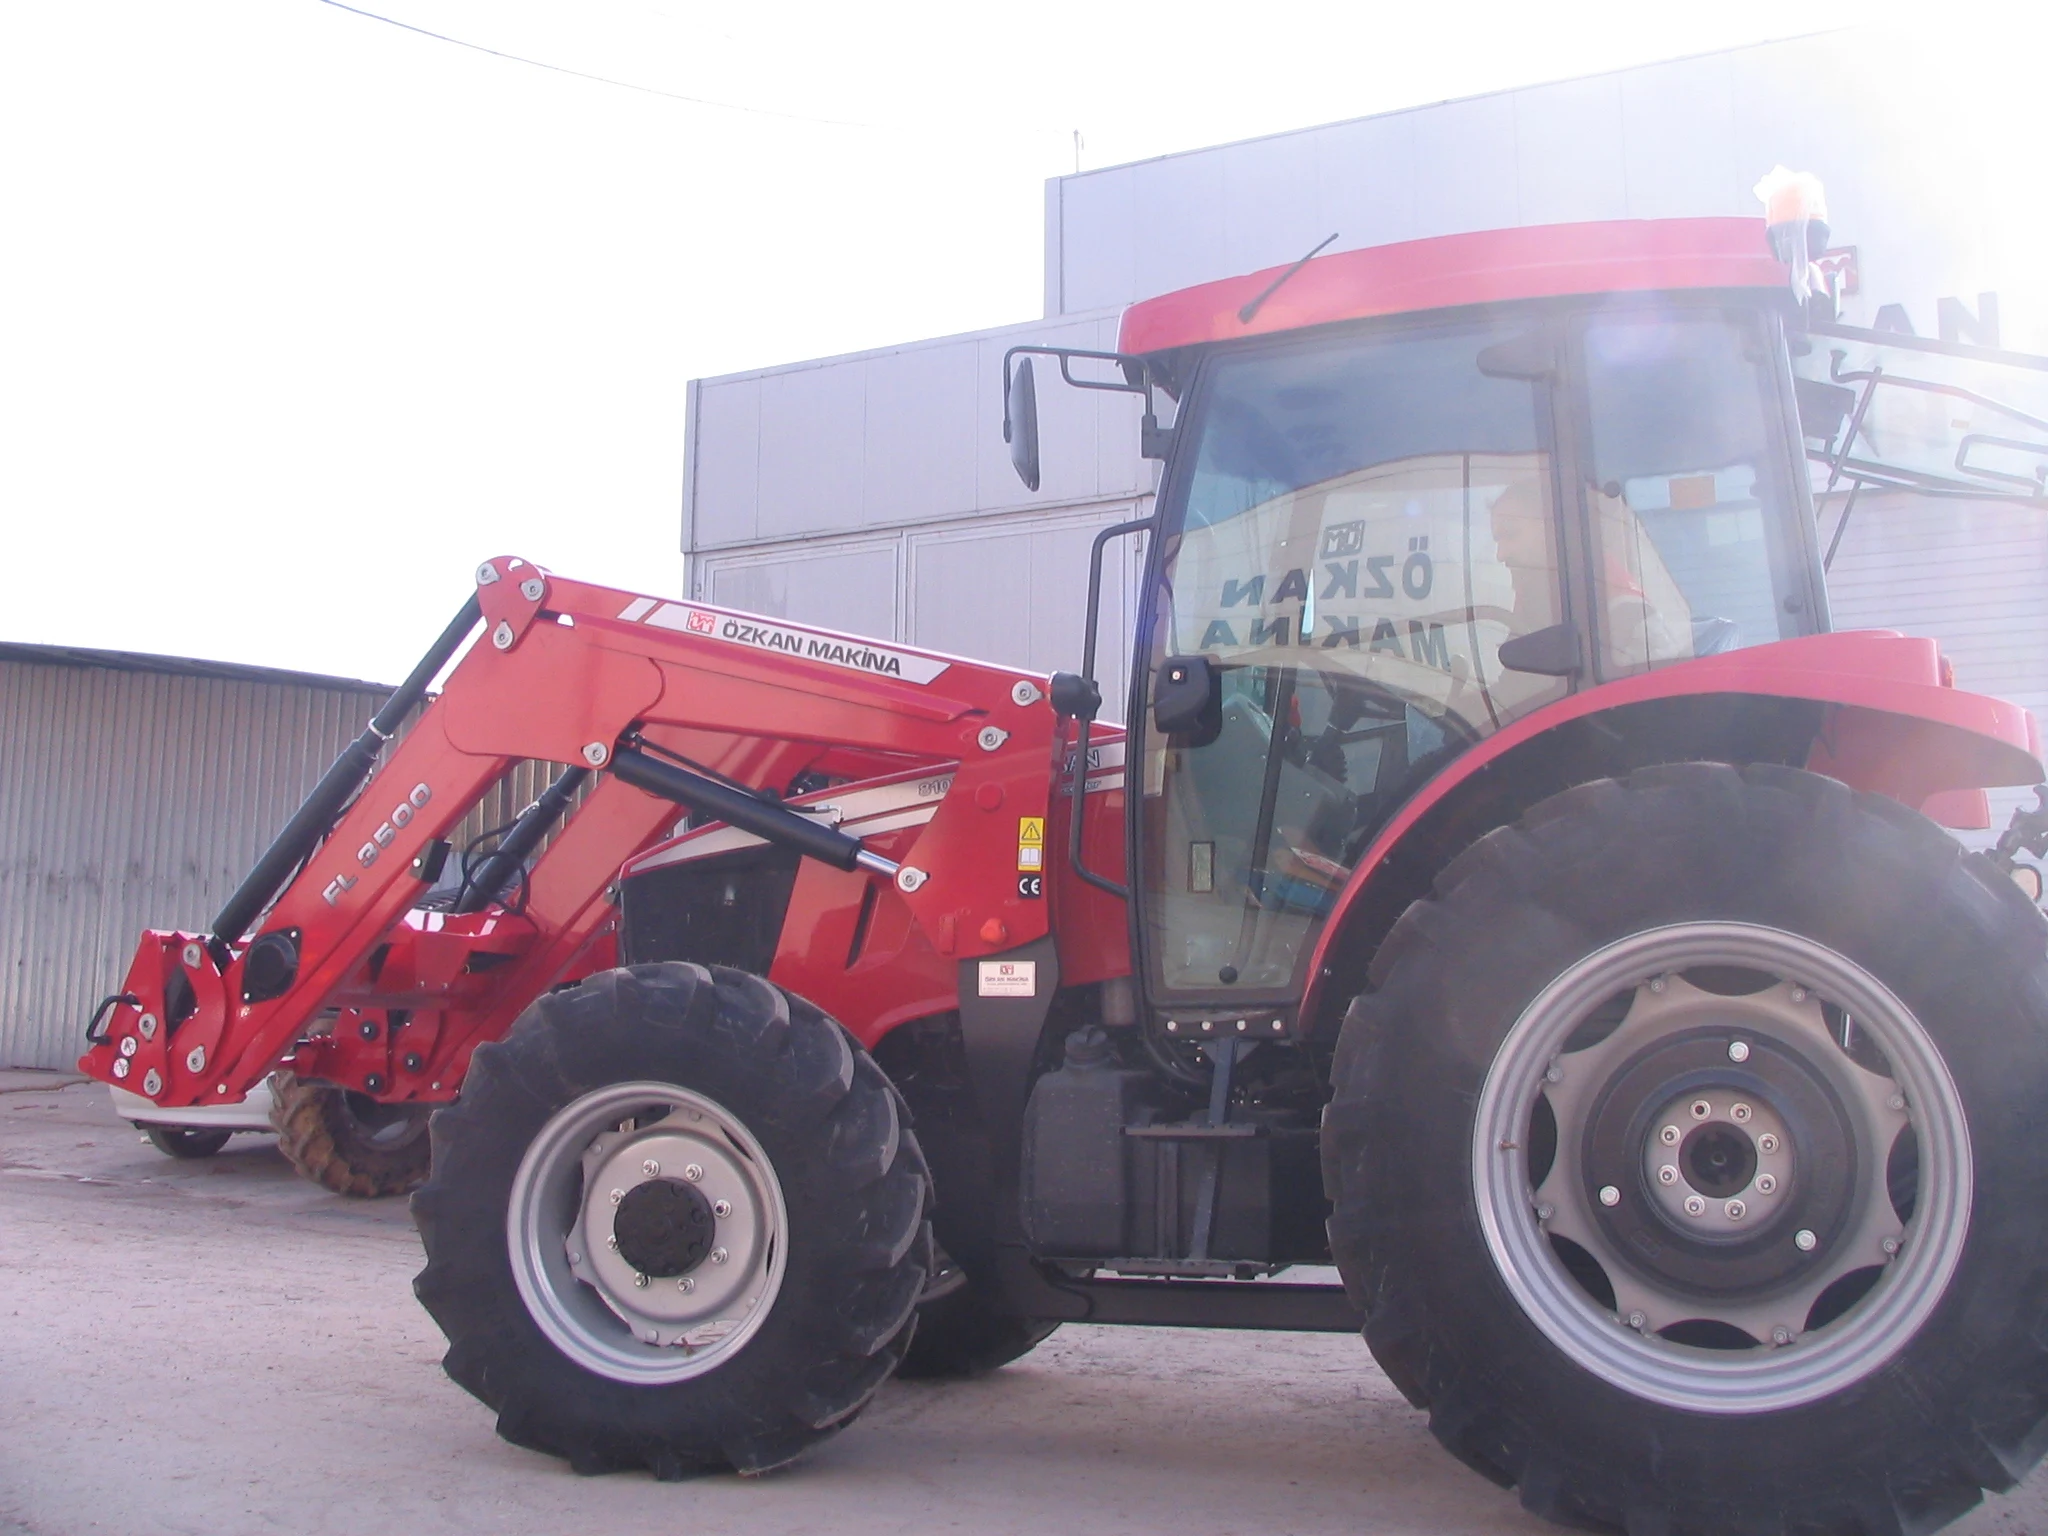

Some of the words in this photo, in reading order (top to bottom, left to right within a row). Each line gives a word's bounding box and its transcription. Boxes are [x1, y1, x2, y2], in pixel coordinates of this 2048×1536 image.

[722, 619, 802, 653] ÖZKAN
[807, 639, 902, 677] MAKİNA
[918, 778, 954, 797] 810
[322, 873, 358, 907] FL
[357, 782, 432, 869] 3500
[1019, 878, 1040, 895] CE
